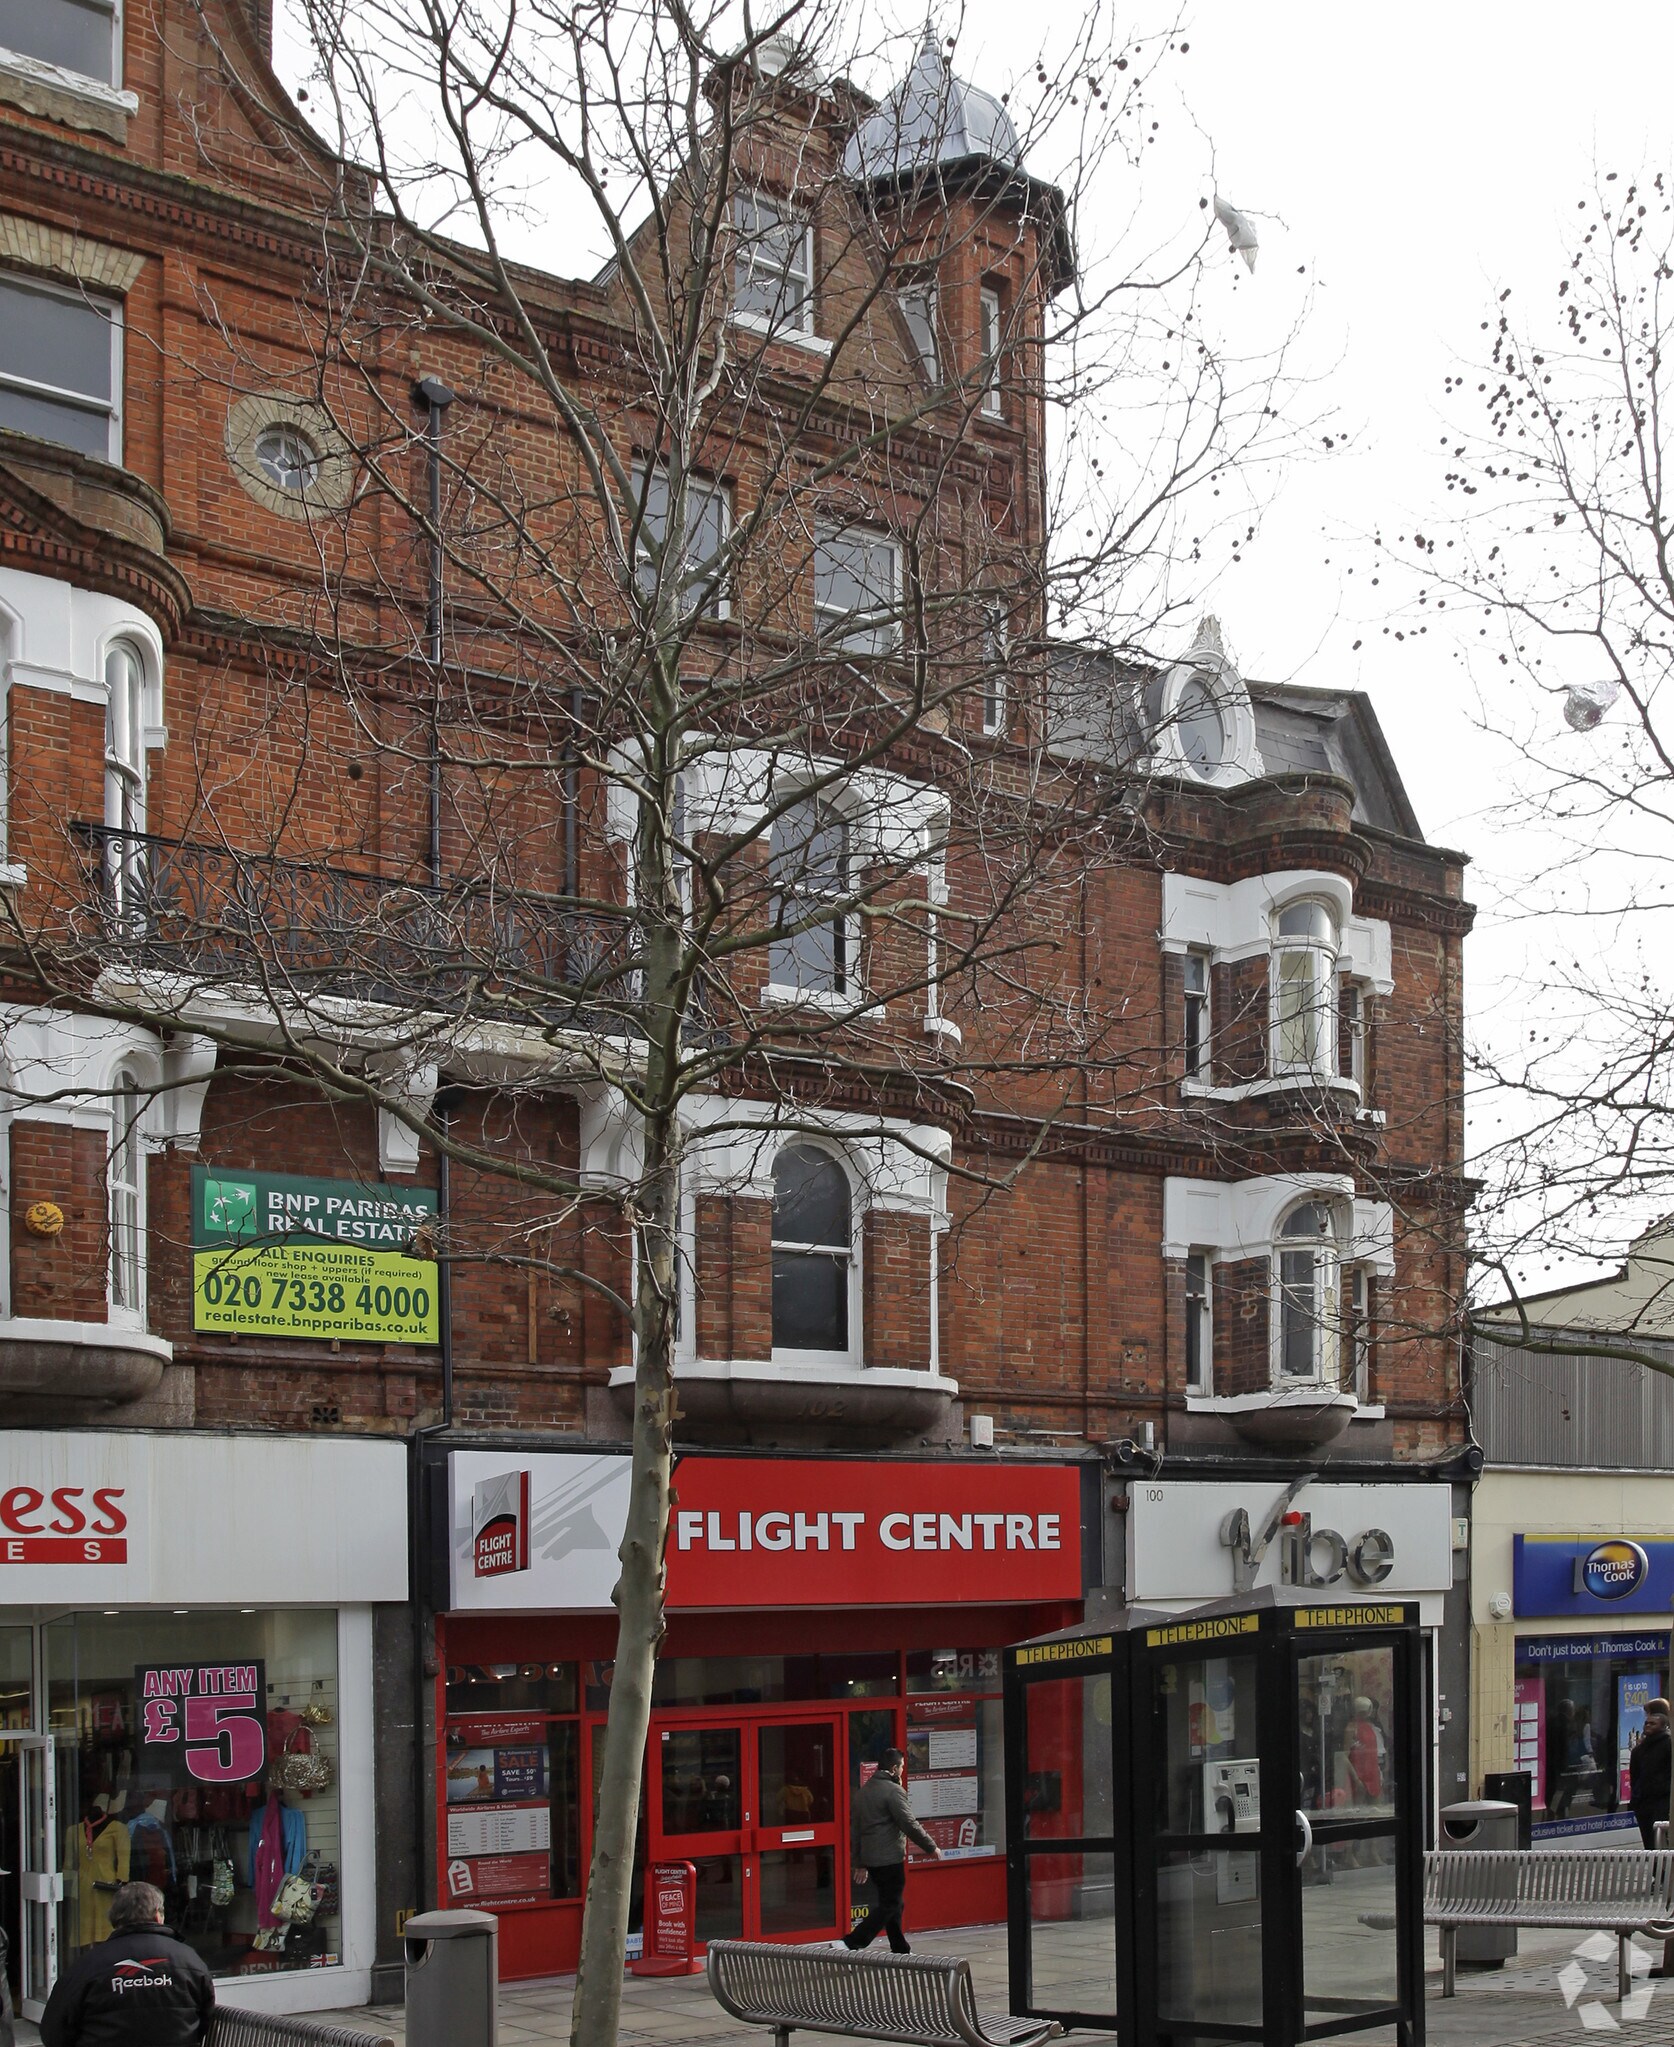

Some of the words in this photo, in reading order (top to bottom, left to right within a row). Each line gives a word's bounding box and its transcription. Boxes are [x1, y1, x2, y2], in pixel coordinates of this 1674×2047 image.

[268, 1191, 320, 1213] BNP
[326, 1197, 429, 1223] PARIBAS
[268, 1213, 332, 1236] REAL
[261, 1248, 288, 1260] ALL
[293, 1250, 376, 1267] ENQUIRIES
[266, 1271, 288, 1279] new
[291, 1271, 319, 1281] lease
[322, 1274, 371, 1284] available
[281, 1260, 307, 1272] shop
[322, 1265, 358, 1275] uppers
[360, 1267, 372, 1276] (if
[374, 1269, 422, 1280] required)
[204, 1273, 262, 1309] 020
[271, 1278, 346, 1314] 7338
[355, 1284, 430, 1319] 4000
[205, 1309, 428, 1334] realestate.bnpparibas.co.uk
[1145, 1490, 1164, 1502] 100
[676, 1511, 866, 1551] FLIGHT
[878, 1512, 1062, 1551] CENTRE
[1220, 1473, 1395, 1592] Vibe
[479, 1532, 512, 1553] FLIGHT
[477, 1549, 513, 1570] CENTRE
[1586, 1558, 1636, 1575] Thomas
[1603, 1569, 1636, 1583] Cook
[1304, 1606, 1396, 1627] TELEPHONE
[1155, 1616, 1249, 1645] TELEPHONE
[1023, 1638, 1104, 1664] TELEPHONE
[1528, 1644, 1552, 1657] Don't
[1552, 1645, 1569, 1659] just
[1570, 1643, 1592, 1655] book
[1601, 1641, 1634, 1653] Thomas
[1634, 1639, 1656, 1651] Cook
[143, 1669, 194, 1698] ANY
[198, 1665, 258, 1695] ITEM
[143, 1693, 265, 1783] £5
[509, 1725, 530, 1733] Experts
[498, 1754, 539, 1769] SALE
[501, 1769, 520, 1777] SAVE
[1556, 1822, 1574, 1834] ticket
[1574, 1822, 1587, 1832] and
[1587, 1820, 1603, 1830] hotel
[1603, 1817, 1633, 1830] packages
[463, 1896, 536, 1909] www.flightcentre.co.uk
[661, 1893, 681, 1902] PEACE
[669, 1900, 681, 1908] MIND
[657, 1928, 687, 1936] confidence!
[658, 1919, 673, 1927] Book
[673, 1920, 686, 1928] with
[111, 1974, 172, 1995] Reebok
